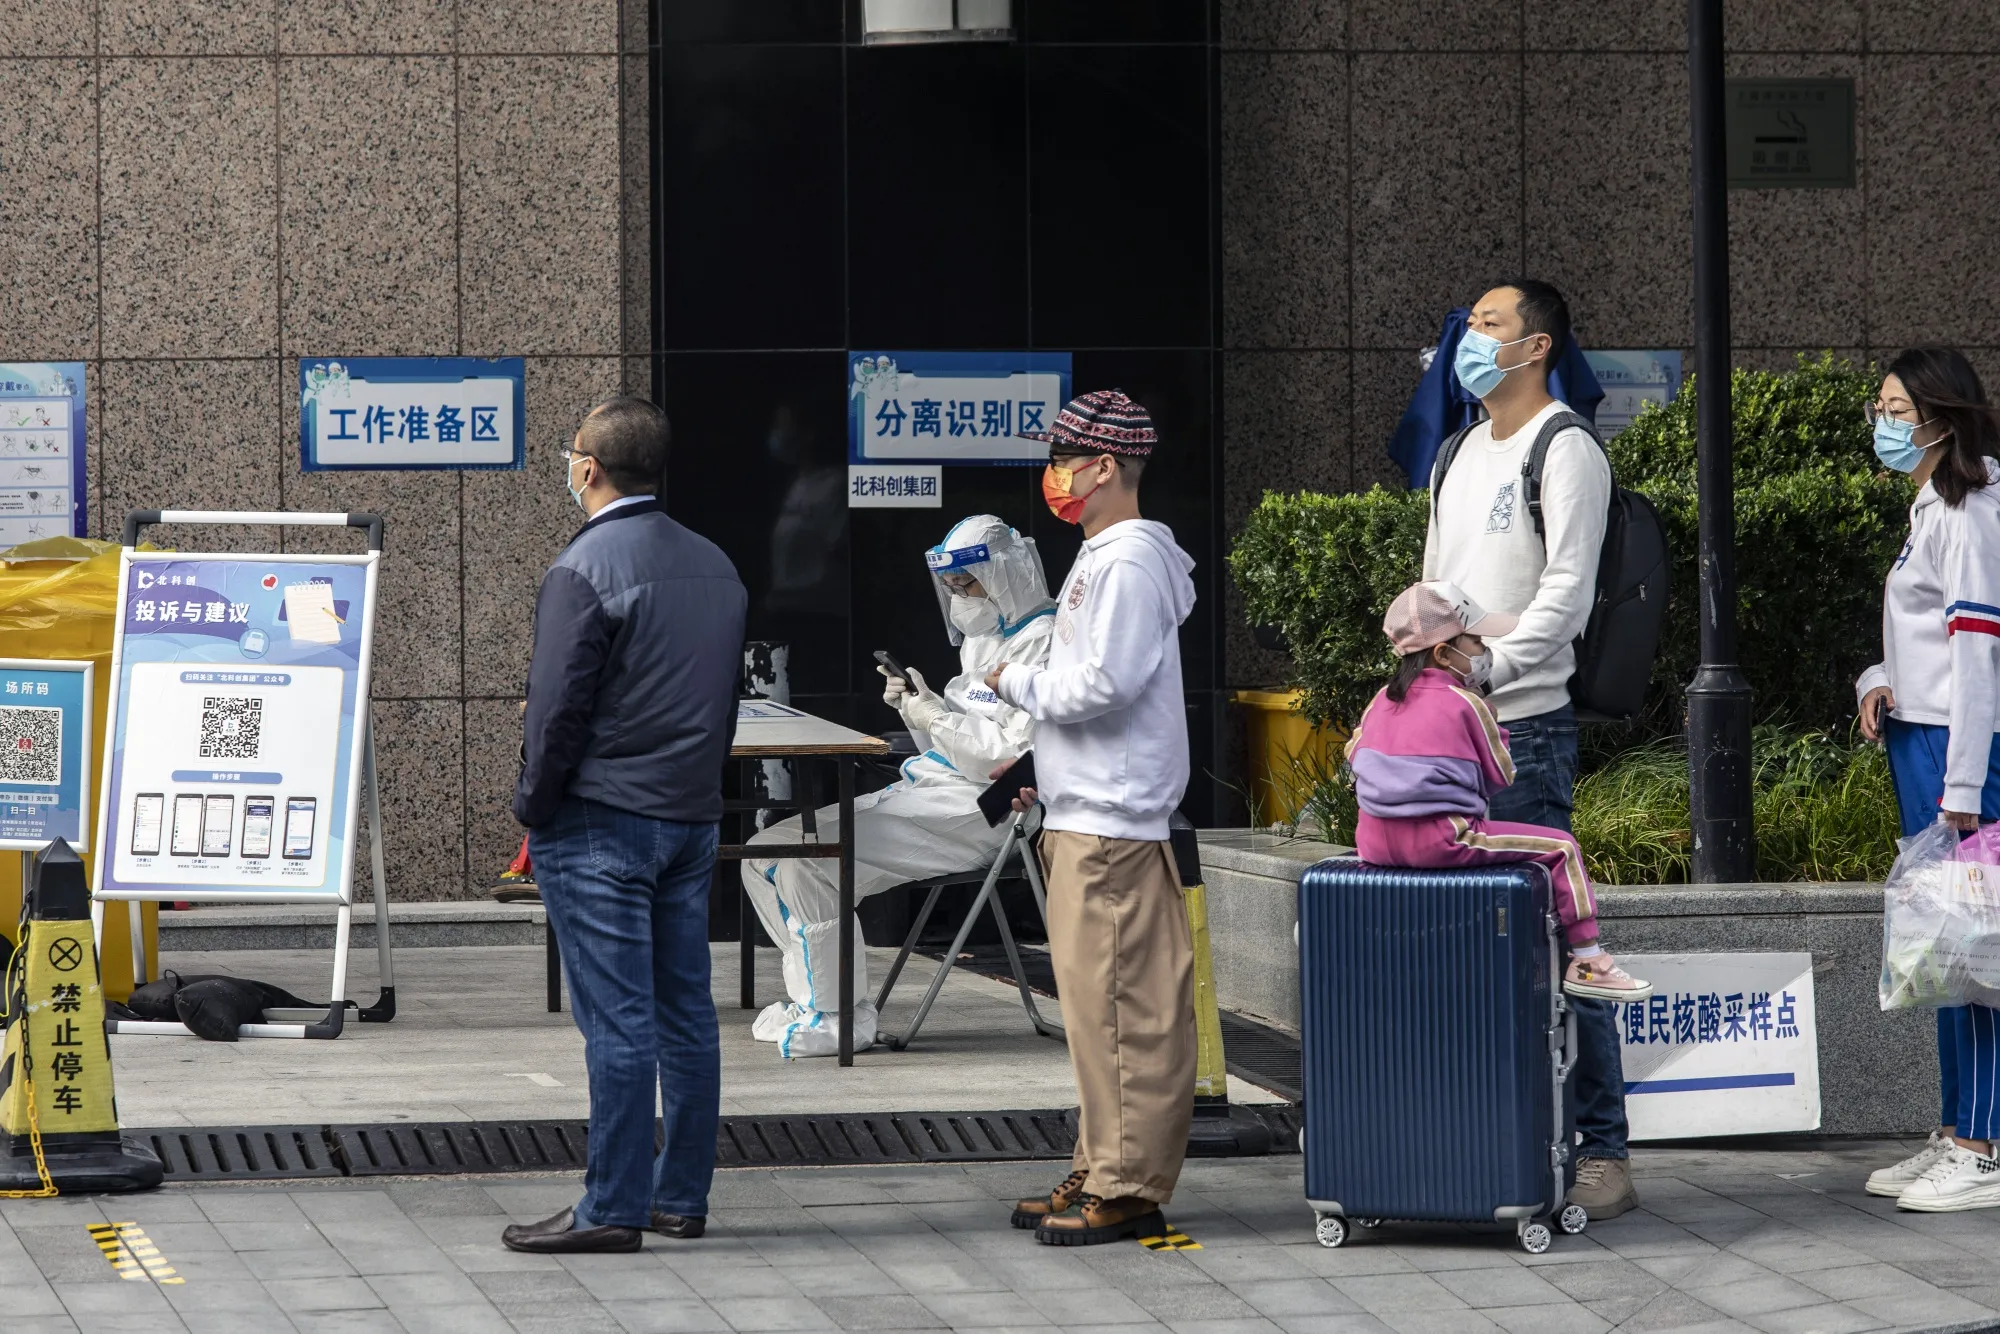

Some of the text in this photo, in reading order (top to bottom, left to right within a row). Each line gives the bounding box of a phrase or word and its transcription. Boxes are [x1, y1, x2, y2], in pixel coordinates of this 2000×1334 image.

[327, 404, 500, 444] 工作准备区
[875, 398, 1047, 437] 分离识别区
[852, 475, 937, 497] 北科创集团
[157, 575, 197, 586] 北科创
[135, 600, 251, 623] 投诉与建议
[5, 680, 50, 696] 场所码
[10, 806, 36, 815] 扫一扫
[51, 982, 84, 1115] 禁止停车
